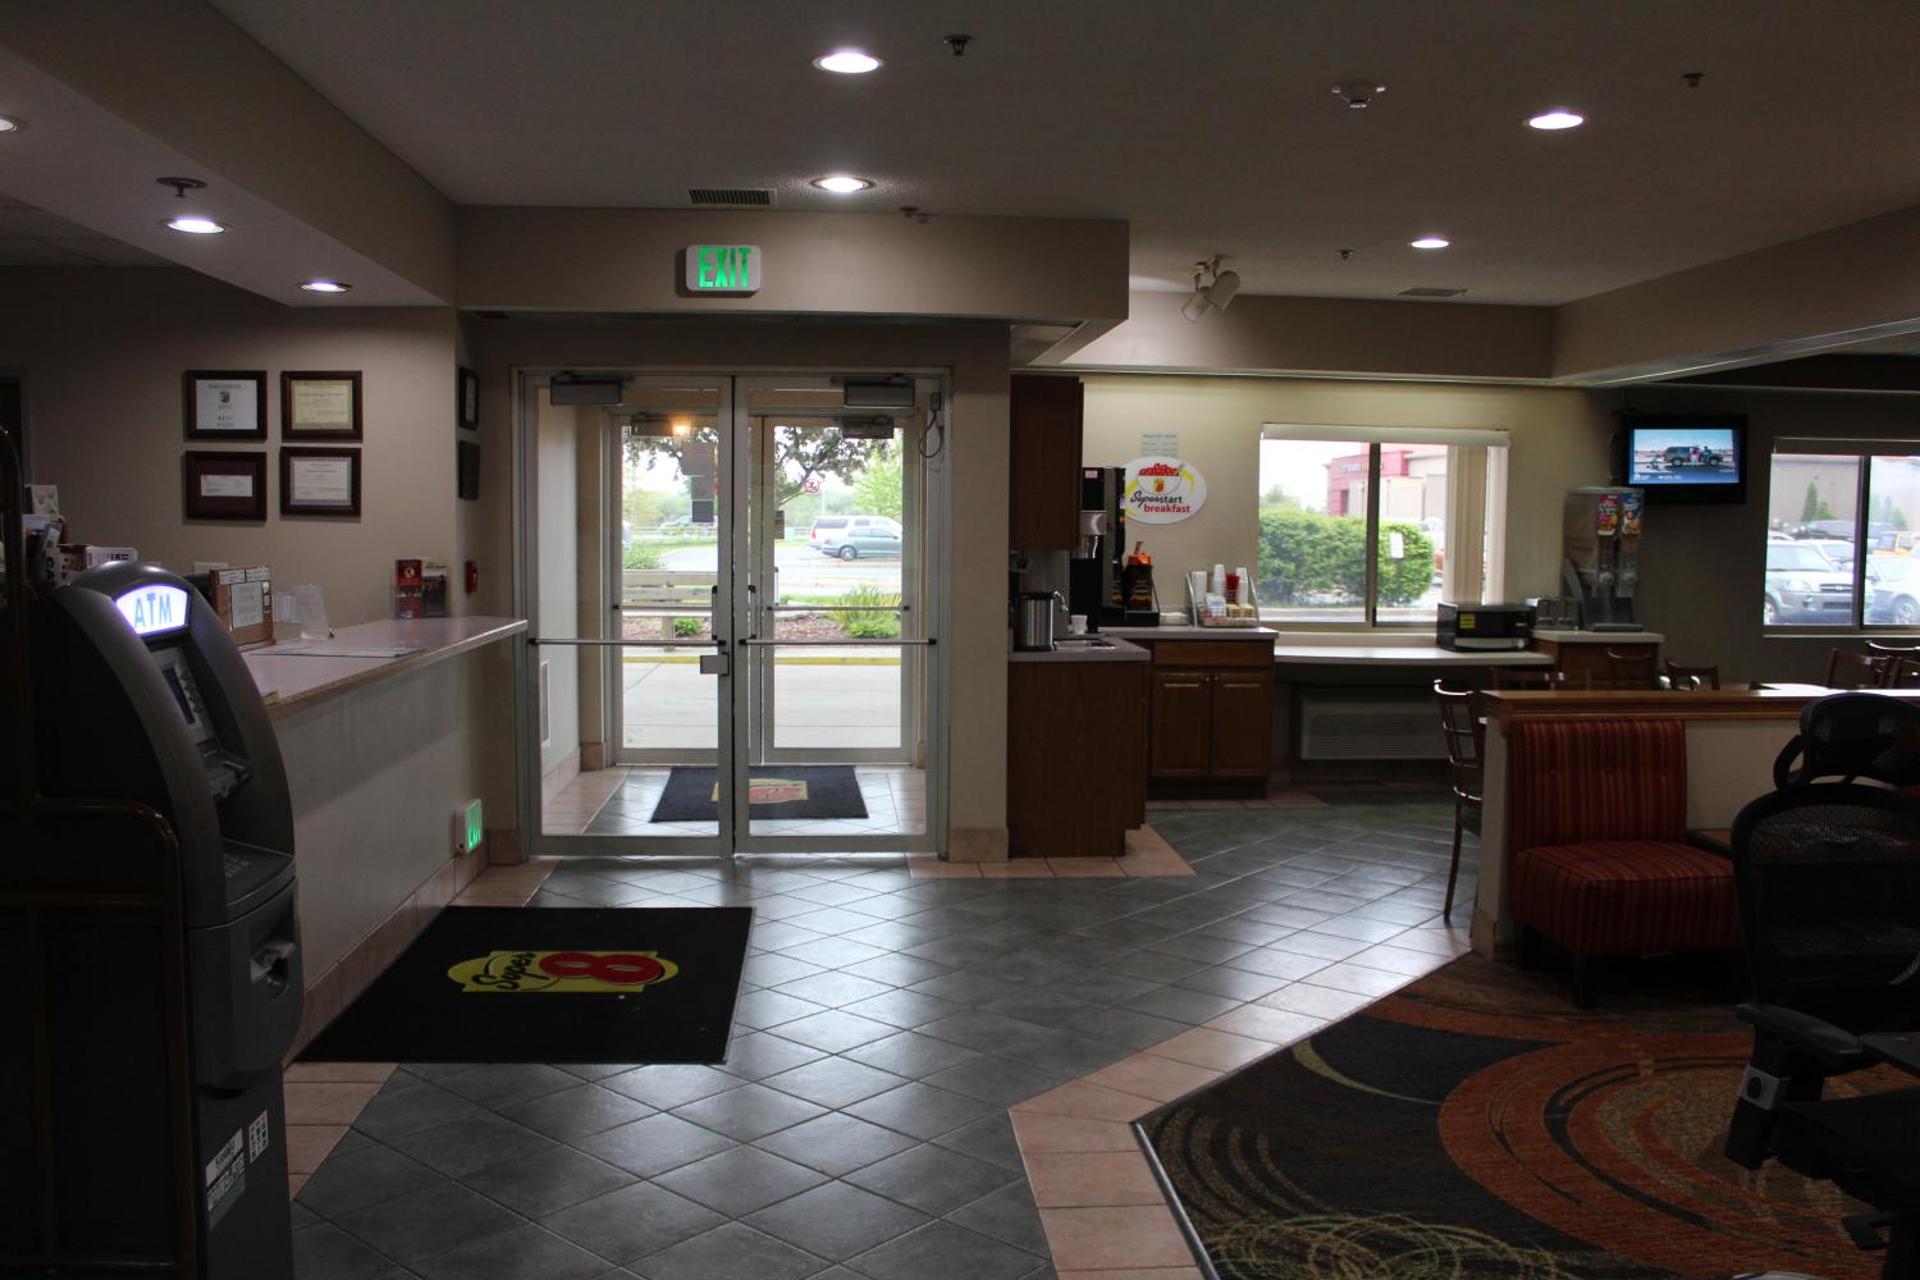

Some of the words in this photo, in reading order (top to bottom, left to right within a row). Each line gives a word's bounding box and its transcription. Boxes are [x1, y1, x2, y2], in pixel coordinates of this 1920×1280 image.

[699, 247, 752, 289] EXIT
[1143, 503, 1190, 513] breakfast
[134, 593, 173, 628] ATM
[472, 951, 549, 990] Super
[538, 952, 665, 984] 8
